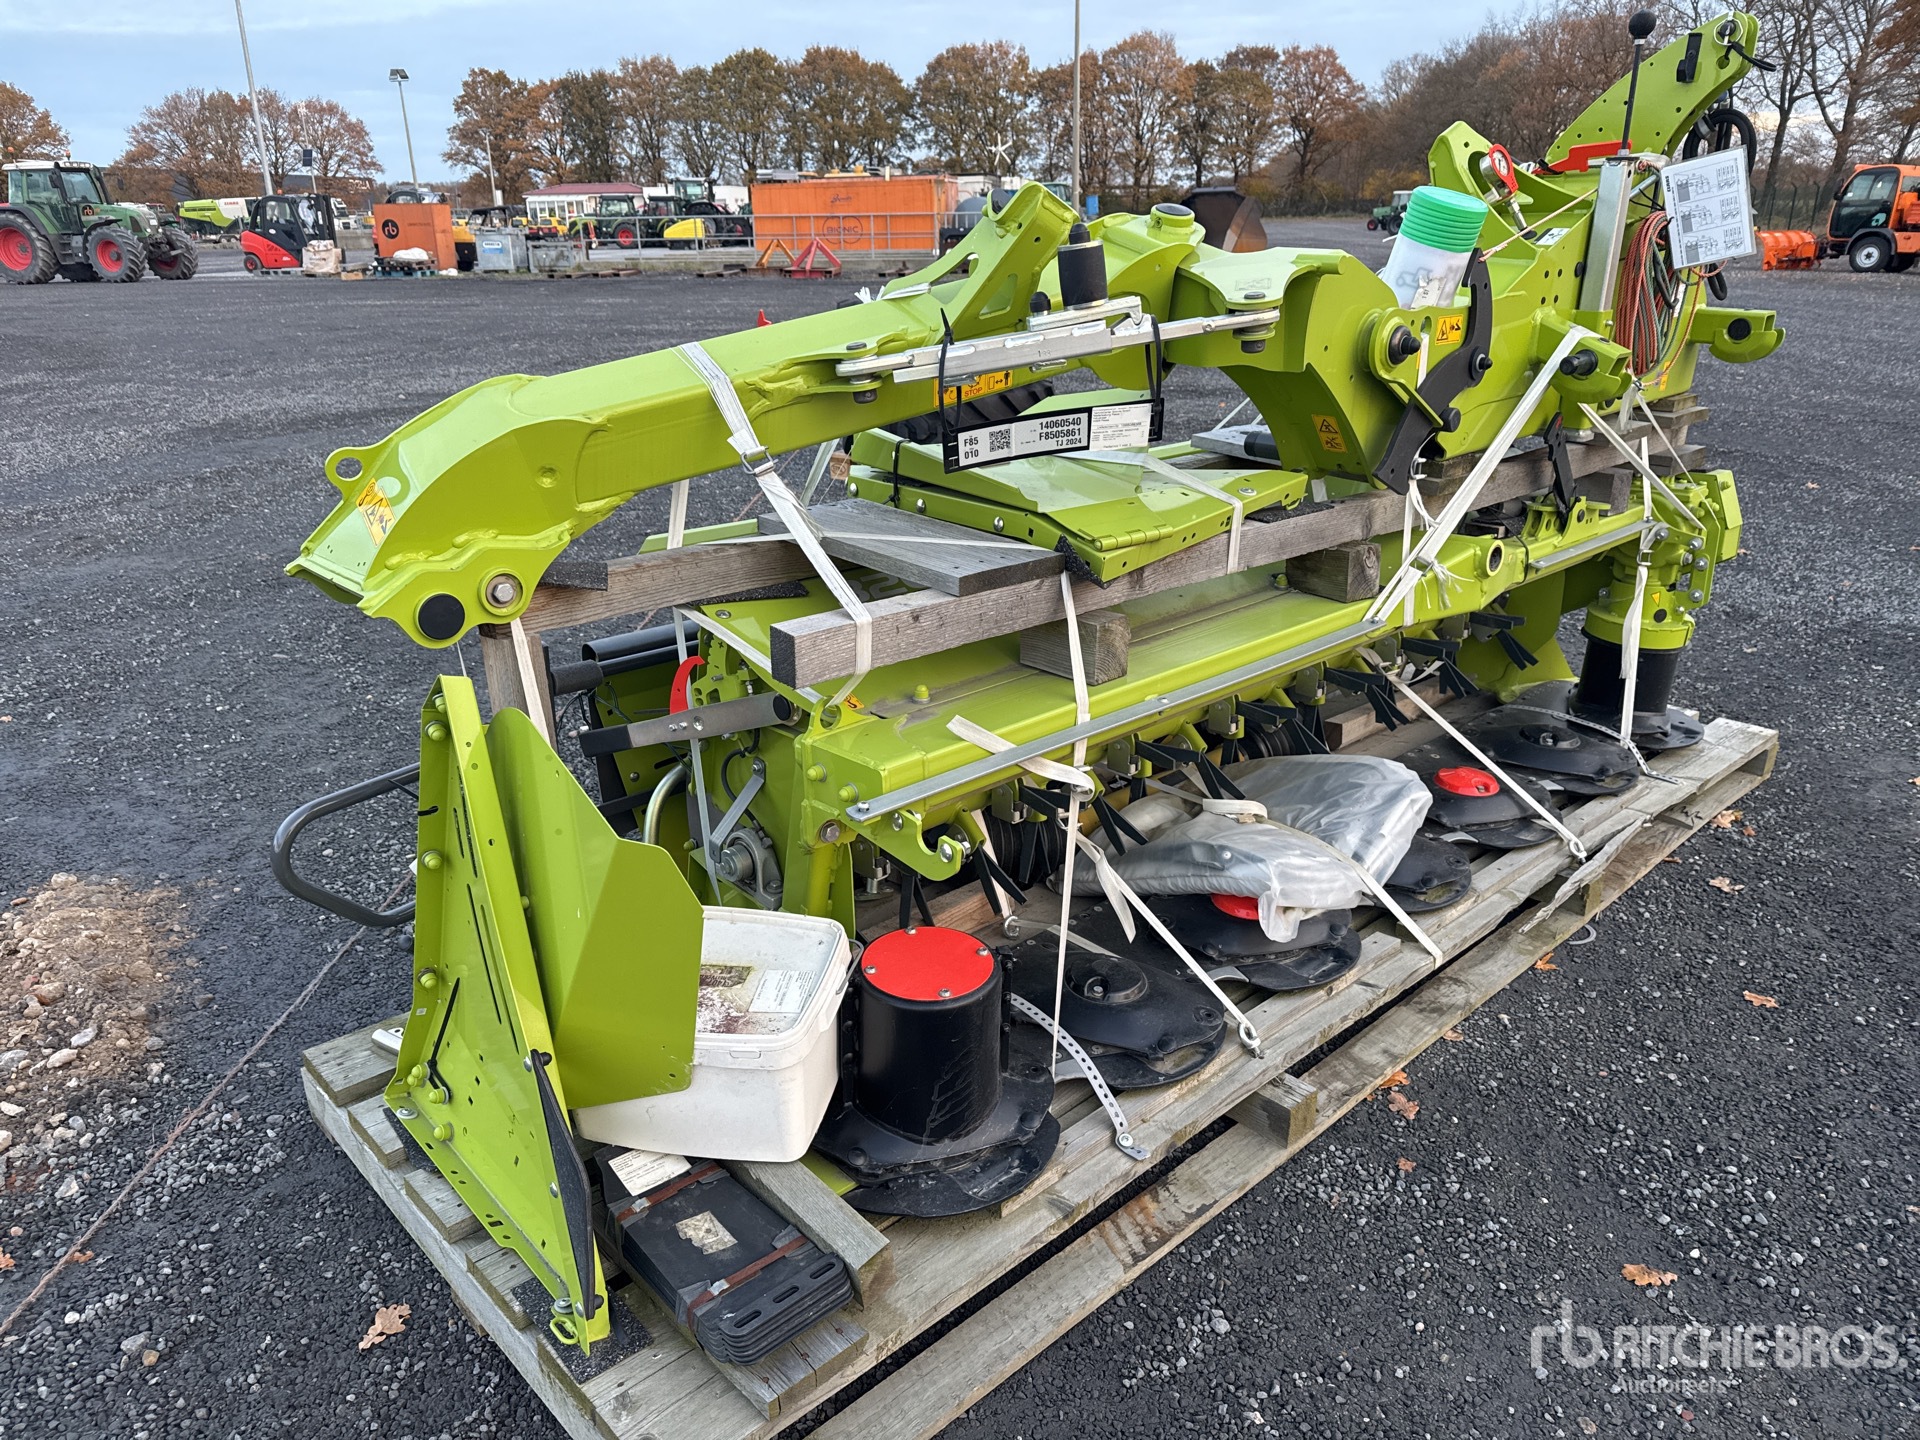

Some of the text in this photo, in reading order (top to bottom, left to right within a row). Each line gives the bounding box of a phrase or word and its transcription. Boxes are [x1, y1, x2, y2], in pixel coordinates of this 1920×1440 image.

[84, 206, 93, 216] rb
[384, 222, 397, 236] rb
[827, 226, 859, 234] BIONIC
[964, 387, 983, 397] STOP
[1039, 417, 1082, 431] 14060540
[1039, 428, 1081, 441] F8505861
[964, 437, 979, 447] F85
[1056, 437, 1082, 447] TJ 2024
[964, 449, 979, 459] 010
